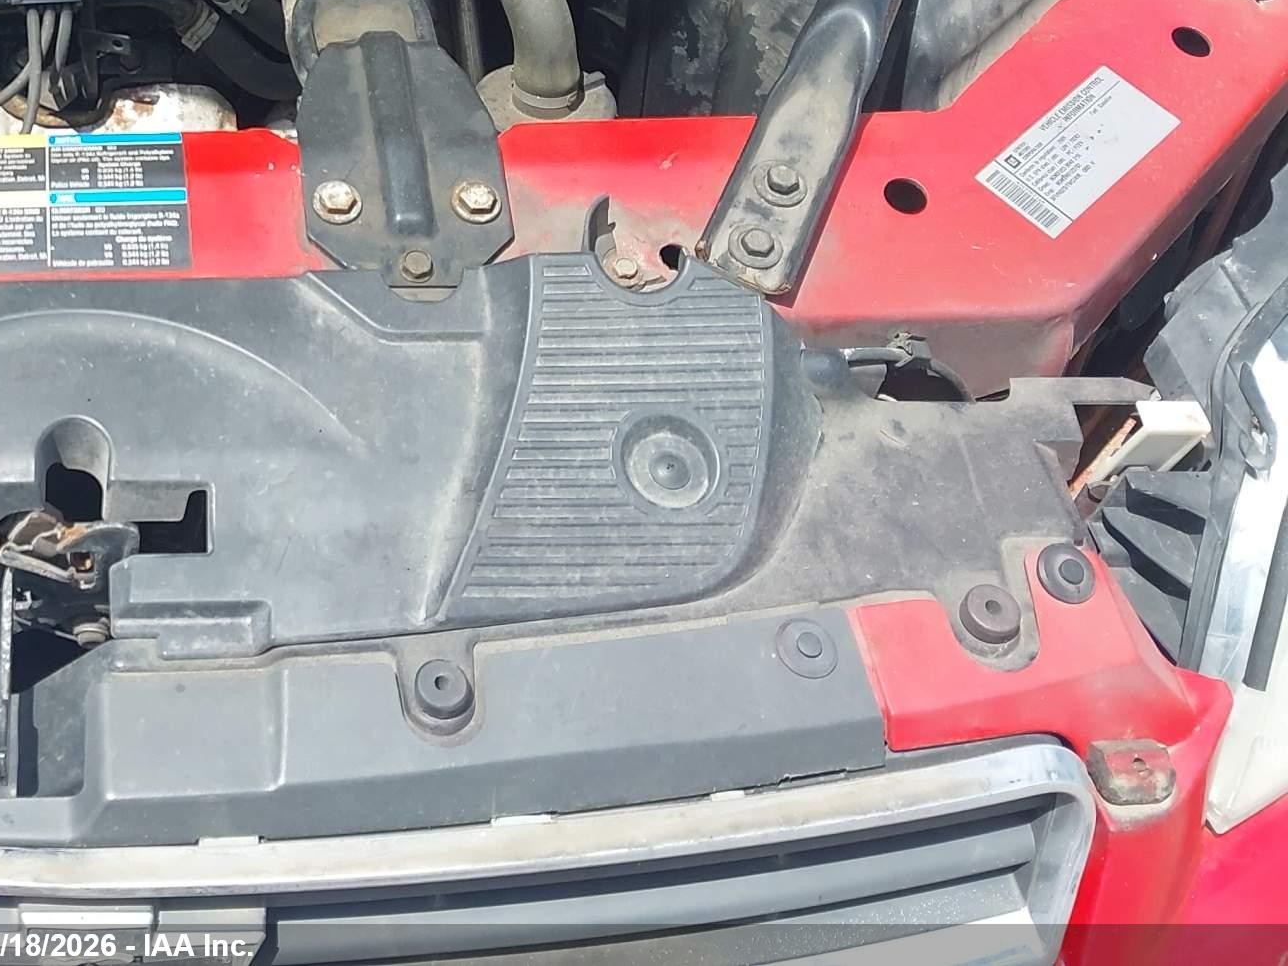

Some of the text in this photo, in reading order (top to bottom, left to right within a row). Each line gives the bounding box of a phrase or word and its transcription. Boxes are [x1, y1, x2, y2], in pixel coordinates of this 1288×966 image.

[1040, 77, 1104, 131] VEHICLE EMISSION CONTROL
[1063, 94, 1096, 122] INFORMATION
